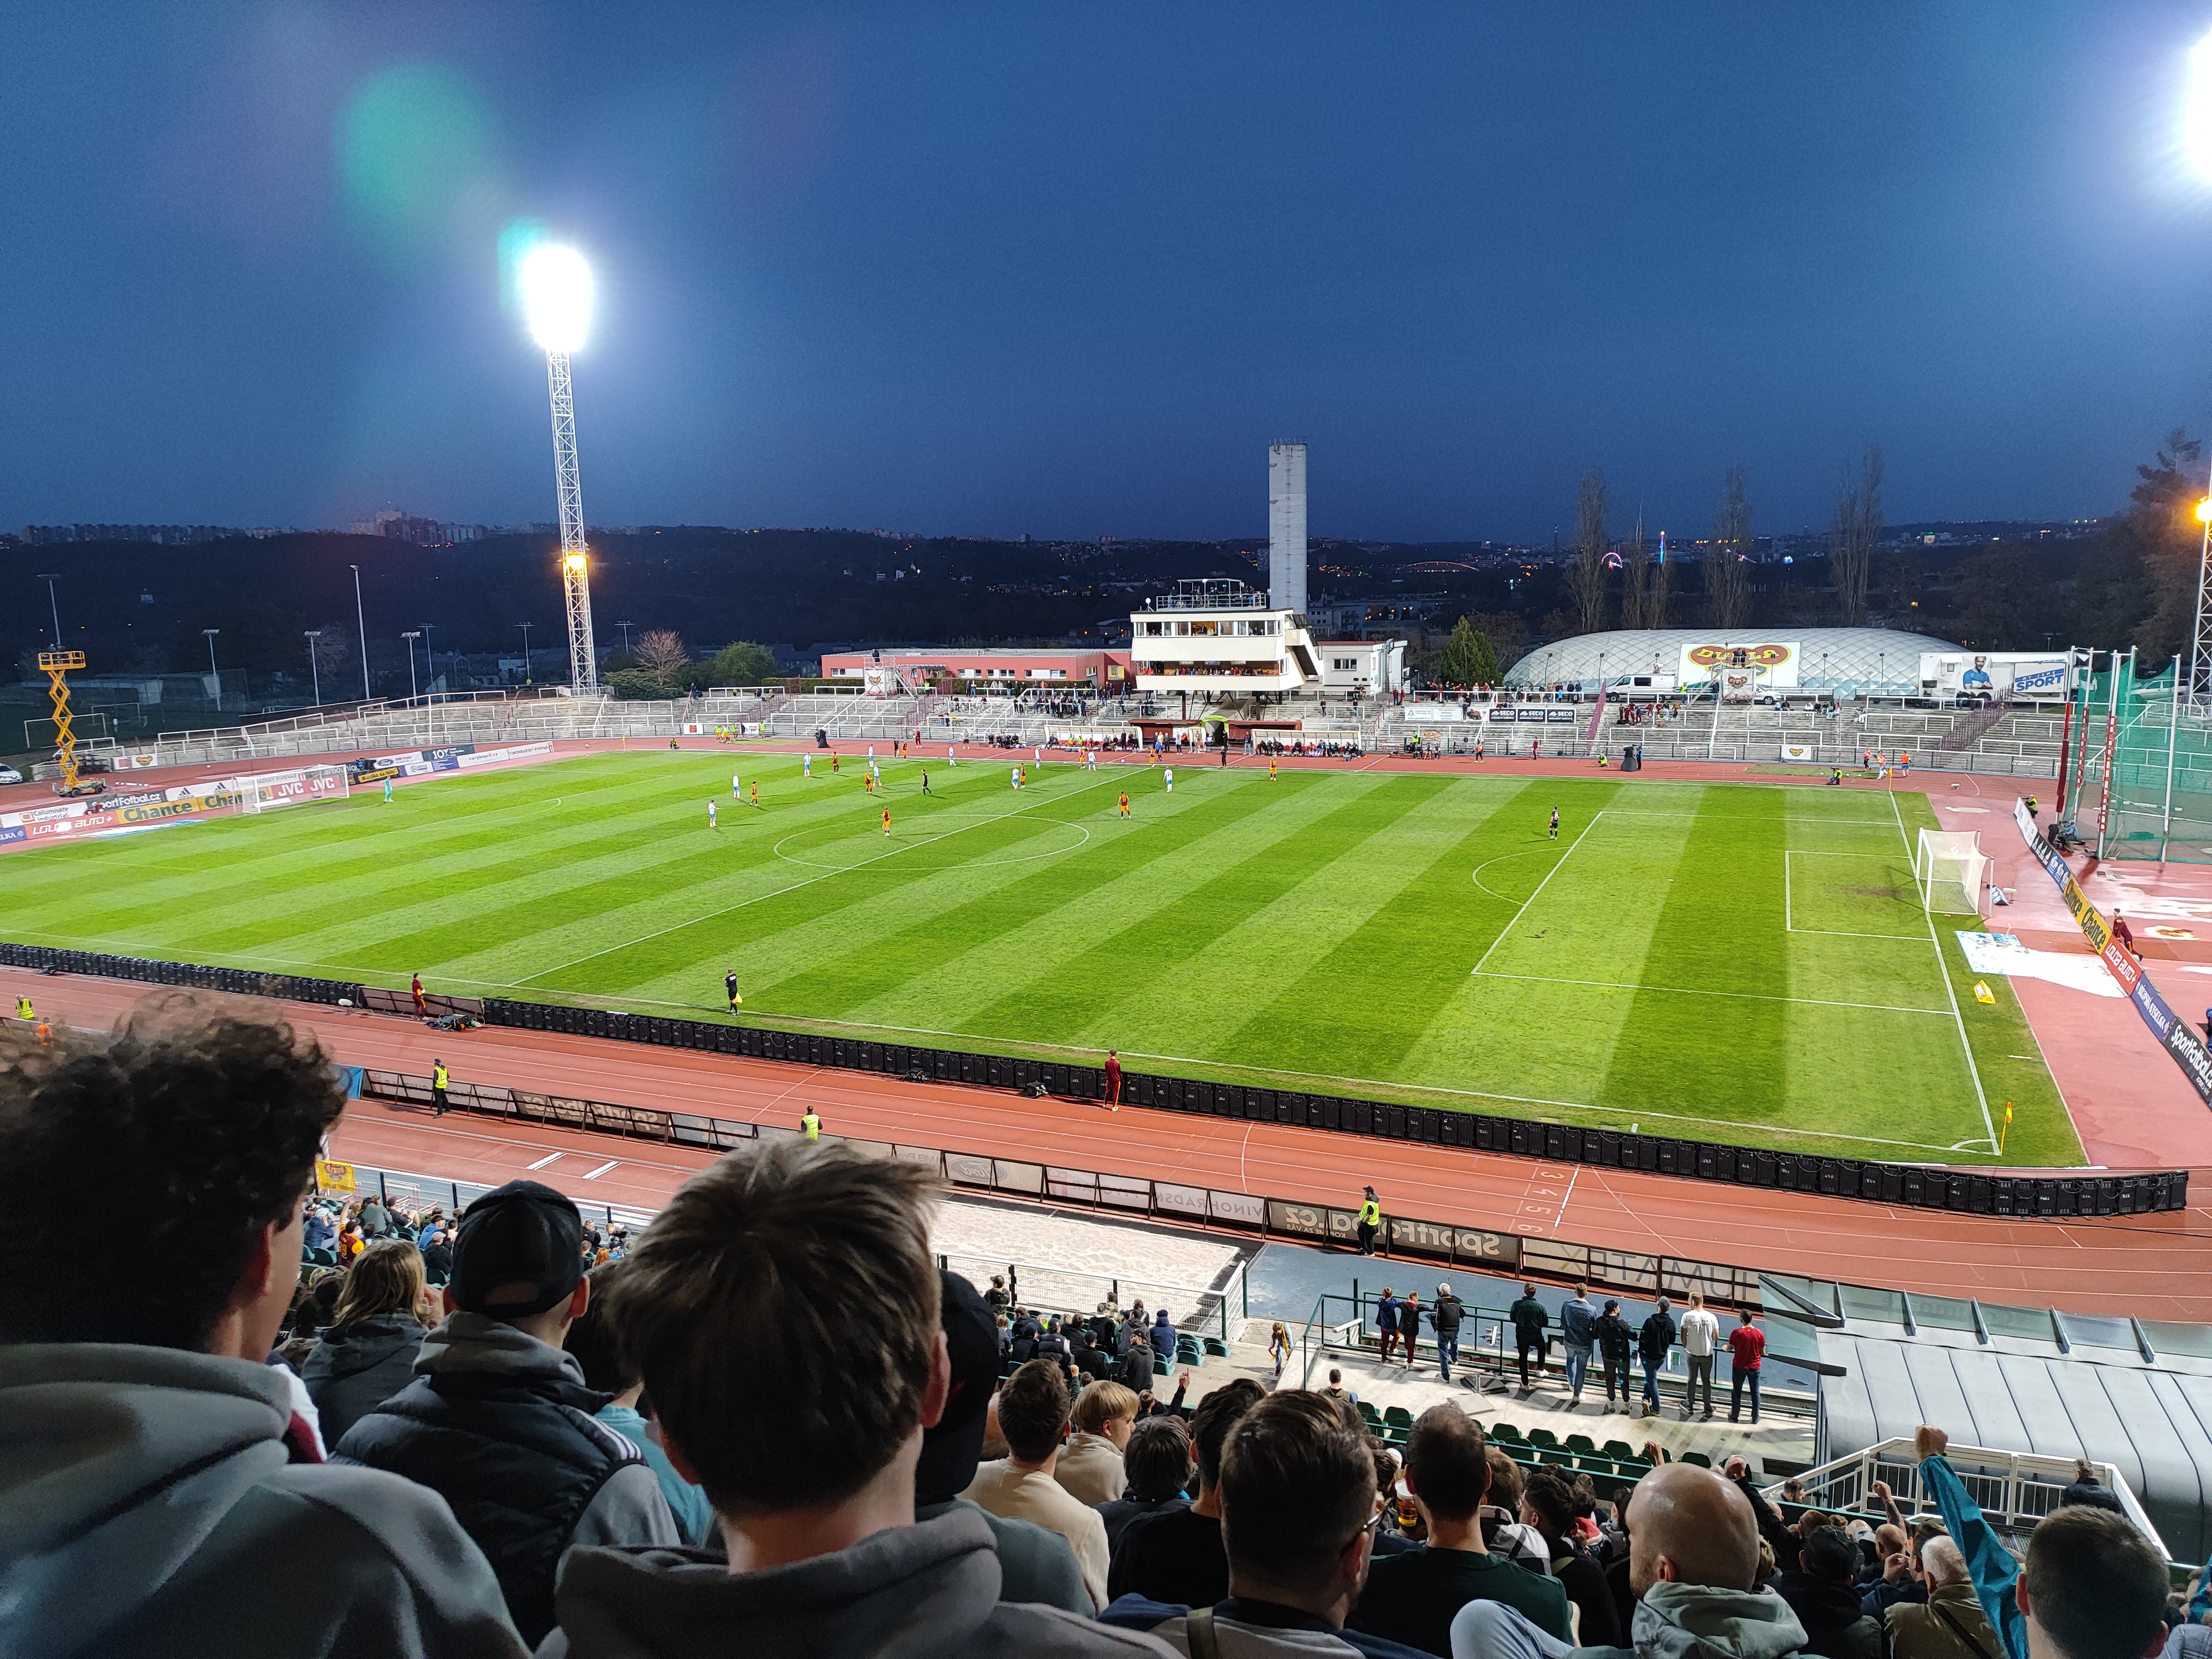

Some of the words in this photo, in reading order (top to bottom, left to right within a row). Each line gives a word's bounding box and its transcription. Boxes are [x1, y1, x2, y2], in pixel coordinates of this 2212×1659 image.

[1697, 648, 1780, 660] DULA
[2016, 674, 2064, 691] SPORT
[278, 783, 304, 796] JVC
[310, 777, 335, 791] JVC
[34, 806, 69, 816] Columnate
[123, 802, 192, 821] Chance
[33, 821, 72, 836] LOU
[2081, 907, 2106, 950] Chance
[1532, 1188, 1558, 1197] 4
[1525, 1206, 1552, 1214] 5
[1517, 1224, 1543, 1233] 6
